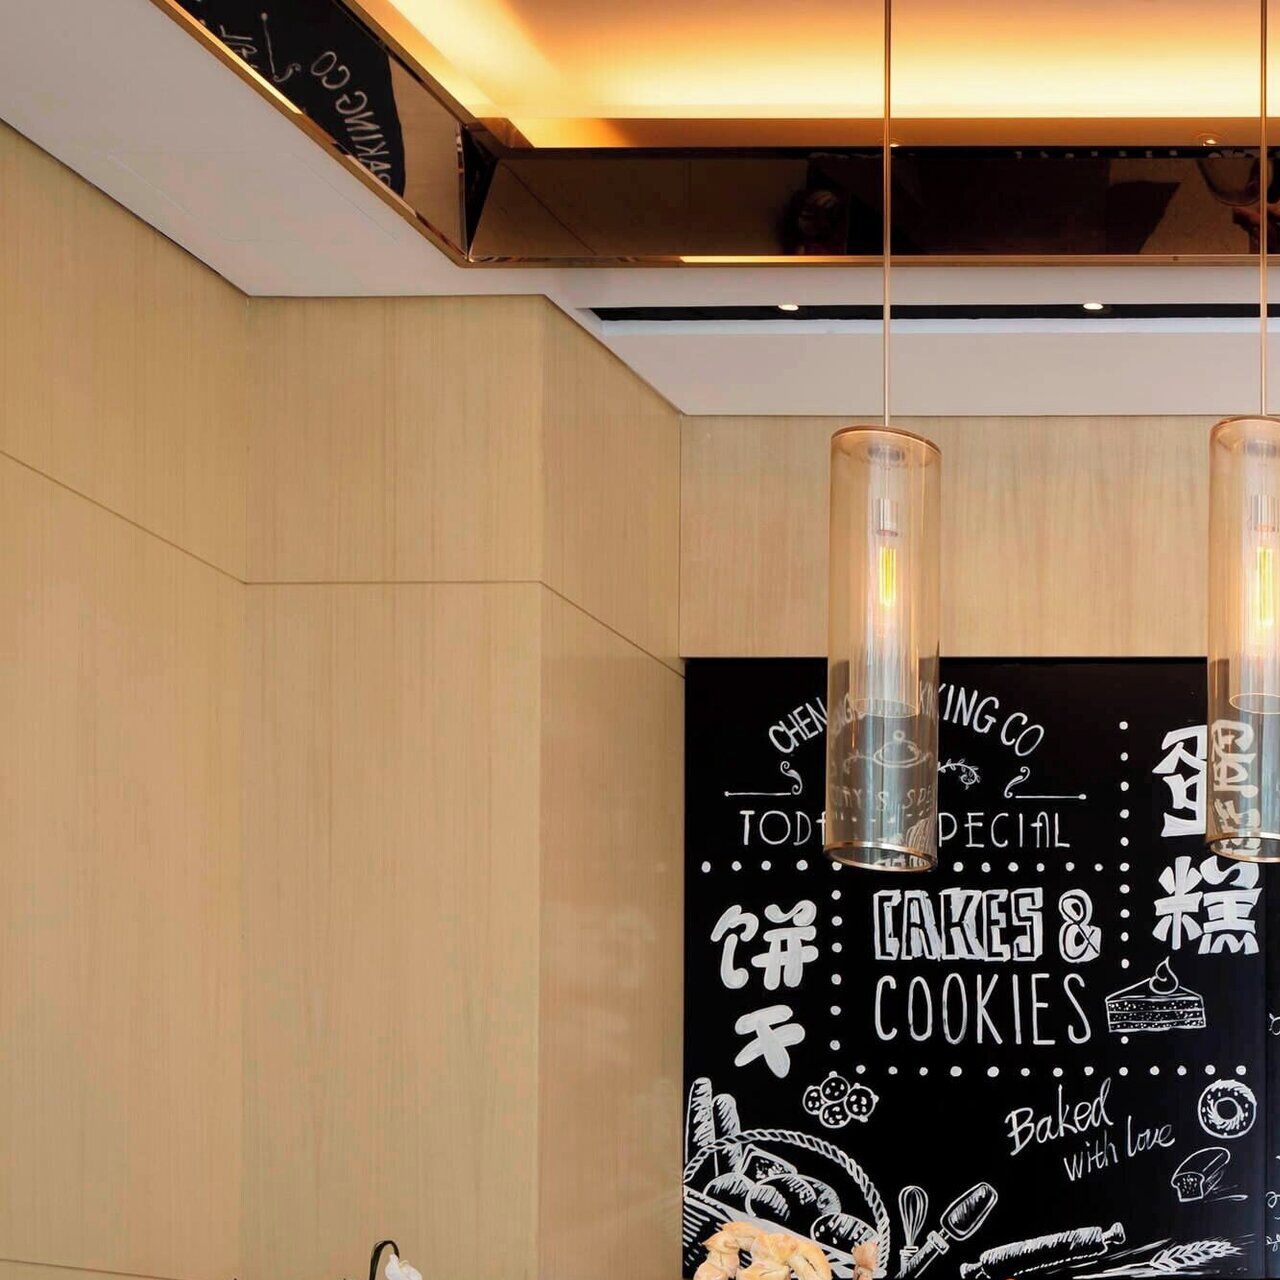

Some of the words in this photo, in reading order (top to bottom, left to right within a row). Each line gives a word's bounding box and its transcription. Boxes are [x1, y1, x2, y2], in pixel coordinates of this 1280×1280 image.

[1001, 713, 1044, 756] CO
[874, 887, 1042, 962] CAKES
[1059, 889, 1101, 963] &
[711, 900, 818, 1078] 饼干
[875, 973, 1091, 1044] COOKIES
[1004, 1077, 1114, 1156] Baked
[1063, 1128, 1119, 1181] with
[1127, 1115, 1176, 1157] love
